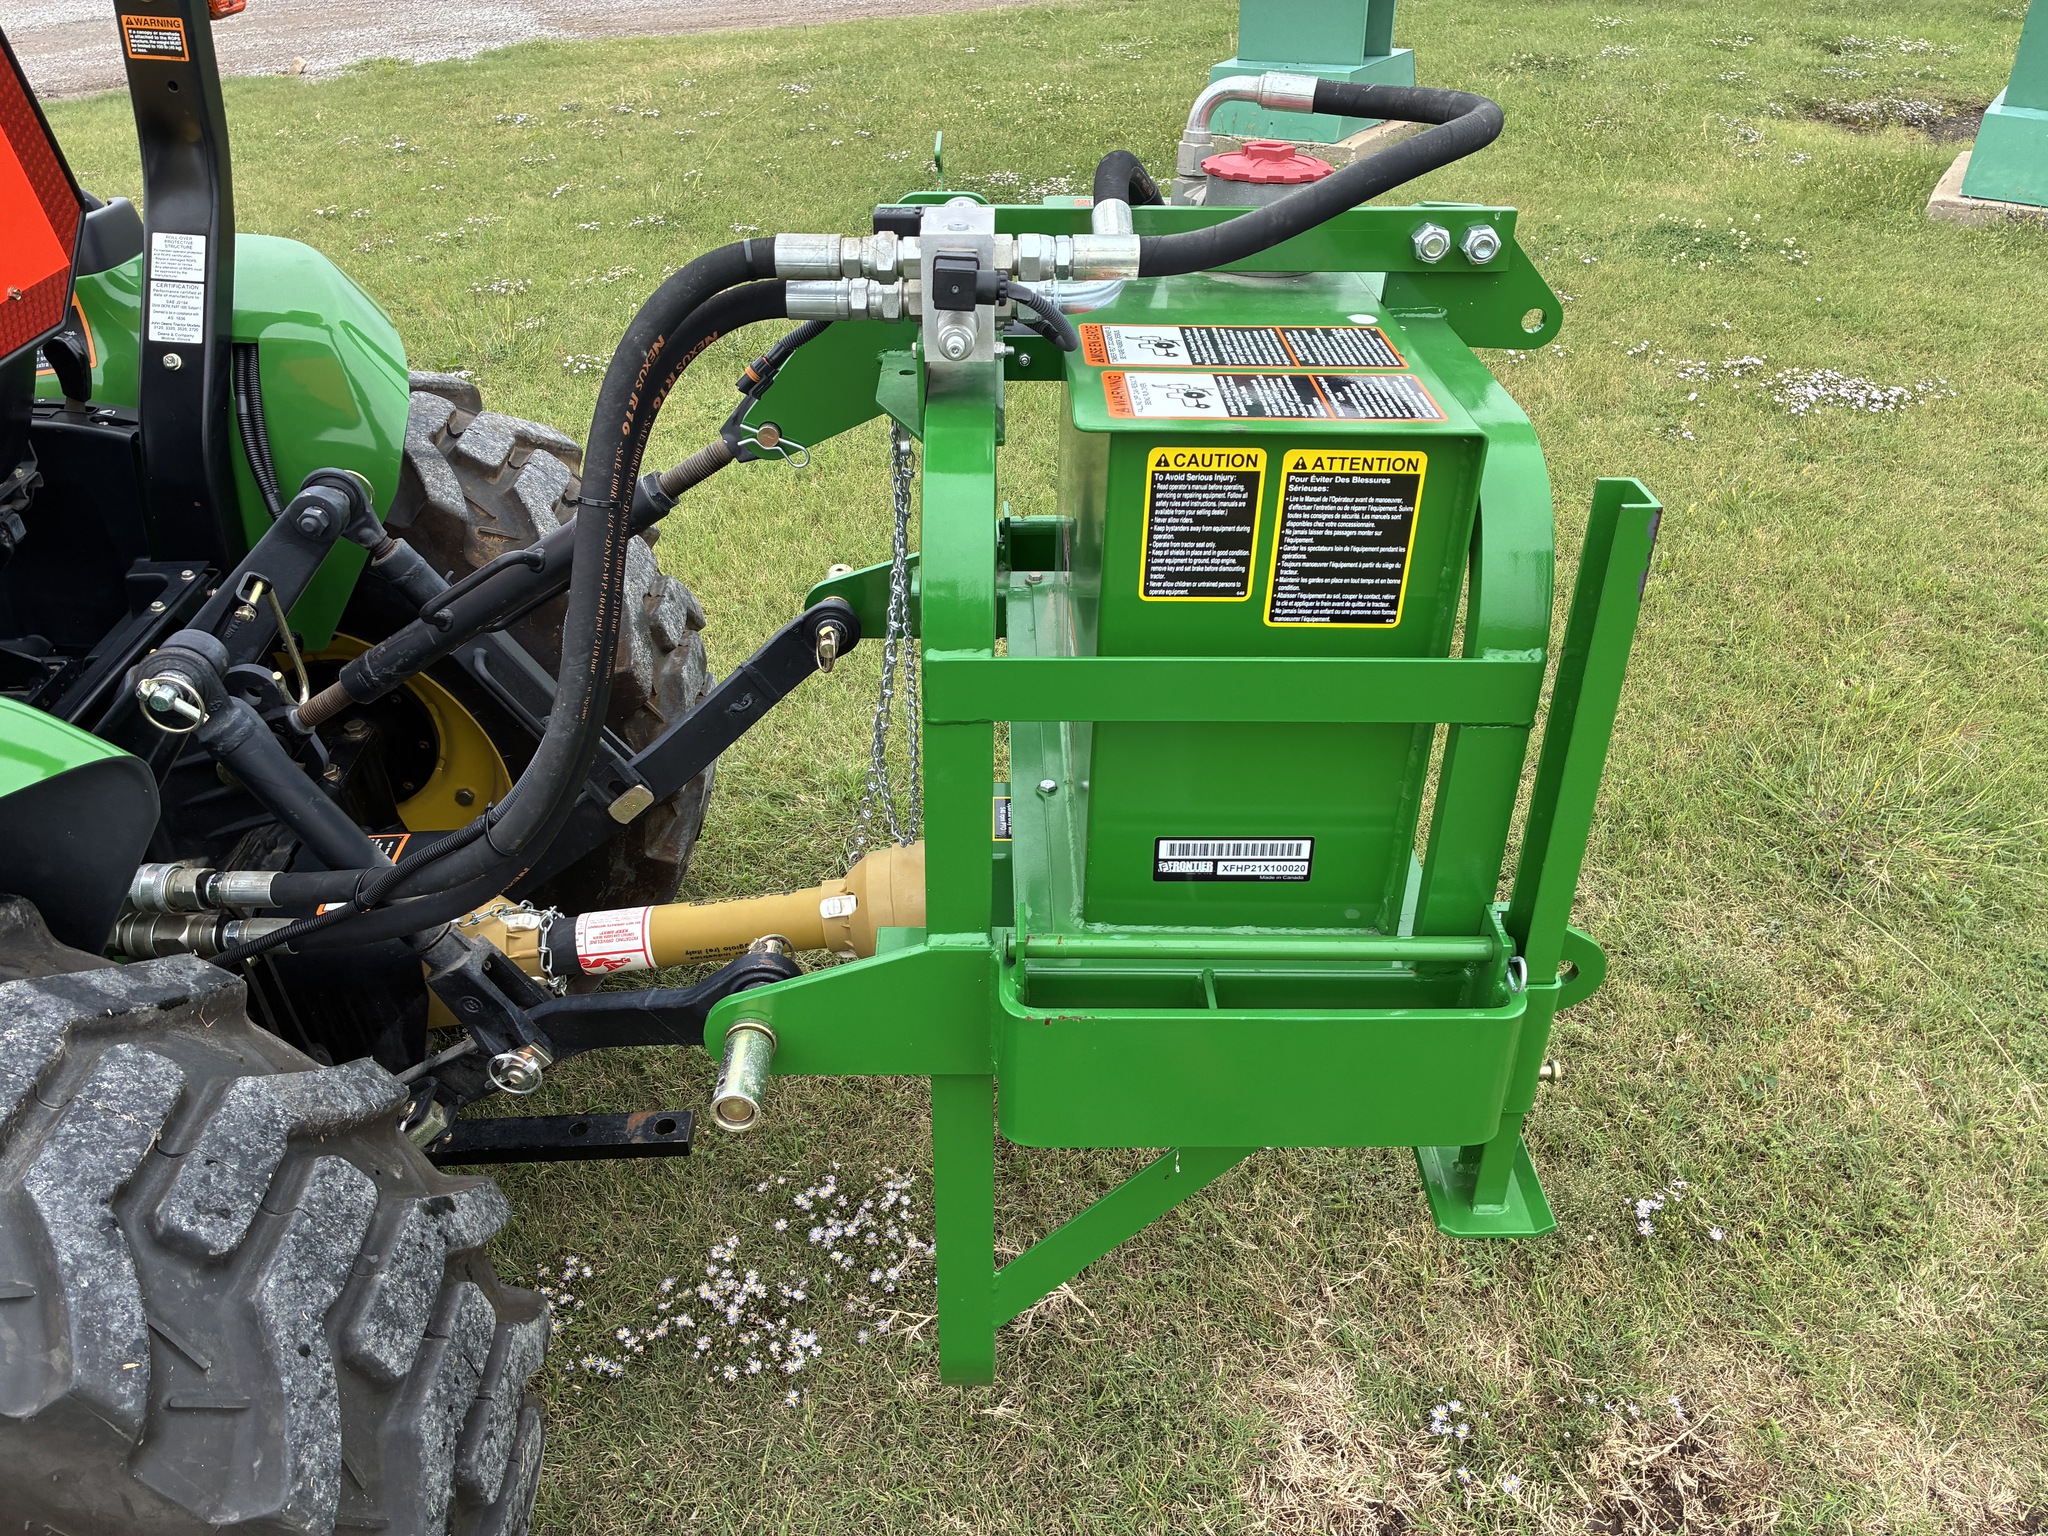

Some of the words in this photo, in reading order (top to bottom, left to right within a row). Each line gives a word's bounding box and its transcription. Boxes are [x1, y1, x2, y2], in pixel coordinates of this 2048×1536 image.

[134, 18, 180, 28] WARNING
[676, 330, 718, 372] NEXUS
[635, 334, 666, 391] NEXUS
[652, 372, 677, 410] R16
[1107, 375, 1128, 406] WARNING
[622, 392, 639, 436] R16
[1174, 454, 1258, 468] CAUTION
[1312, 457, 1419, 472] ATTENTION
[1213, 473, 1236, 481] Injury:
[1309, 474, 1333, 482] Éviter
[1208, 481, 1222, 490] before
[613, 600, 621, 617] 210
[595, 616, 604, 631] psi
[612, 617, 620, 634] bar
[592, 640, 602, 656] 210
[590, 658, 599, 674] bar
[1169, 861, 1214, 873] FRONTIER
